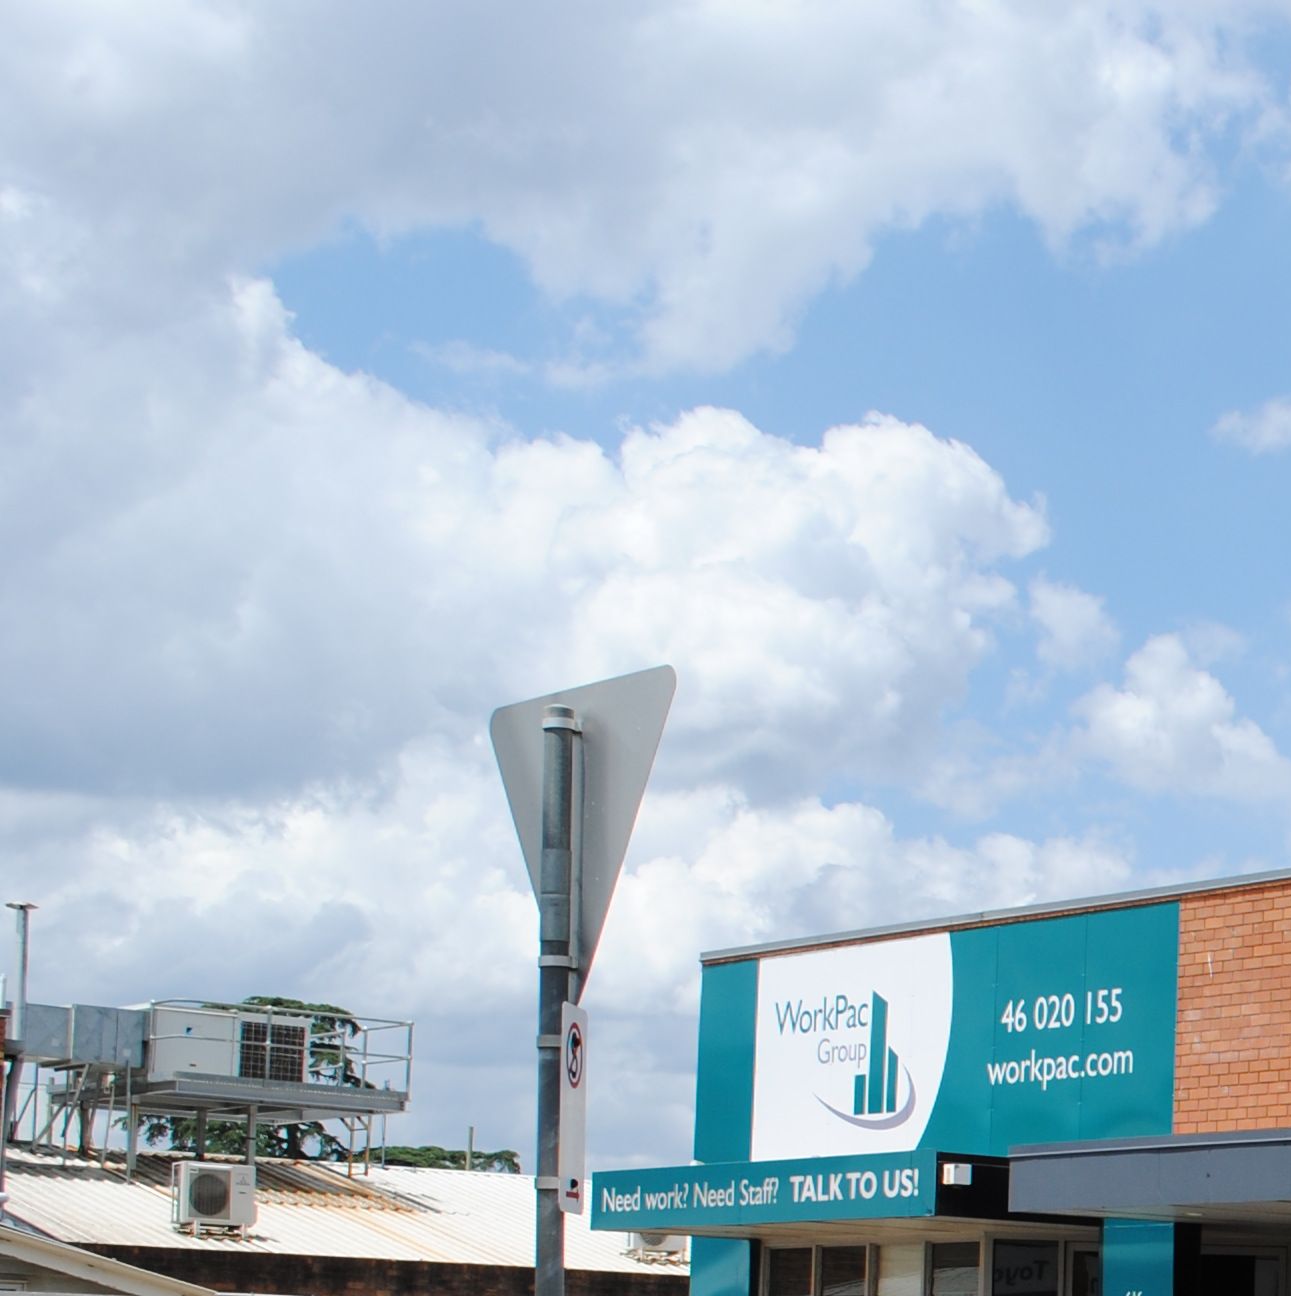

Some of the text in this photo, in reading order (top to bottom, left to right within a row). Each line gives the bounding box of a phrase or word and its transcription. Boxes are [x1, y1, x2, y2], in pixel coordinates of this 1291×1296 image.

[775, 994, 869, 1036] WorkPac
[1001, 988, 1124, 1034] 46 020 155
[816, 1037, 868, 1068] Group
[987, 1048, 1134, 1091] workpac.com
[602, 1167, 920, 1213] Need work? Need Staff? TALK TO US!
